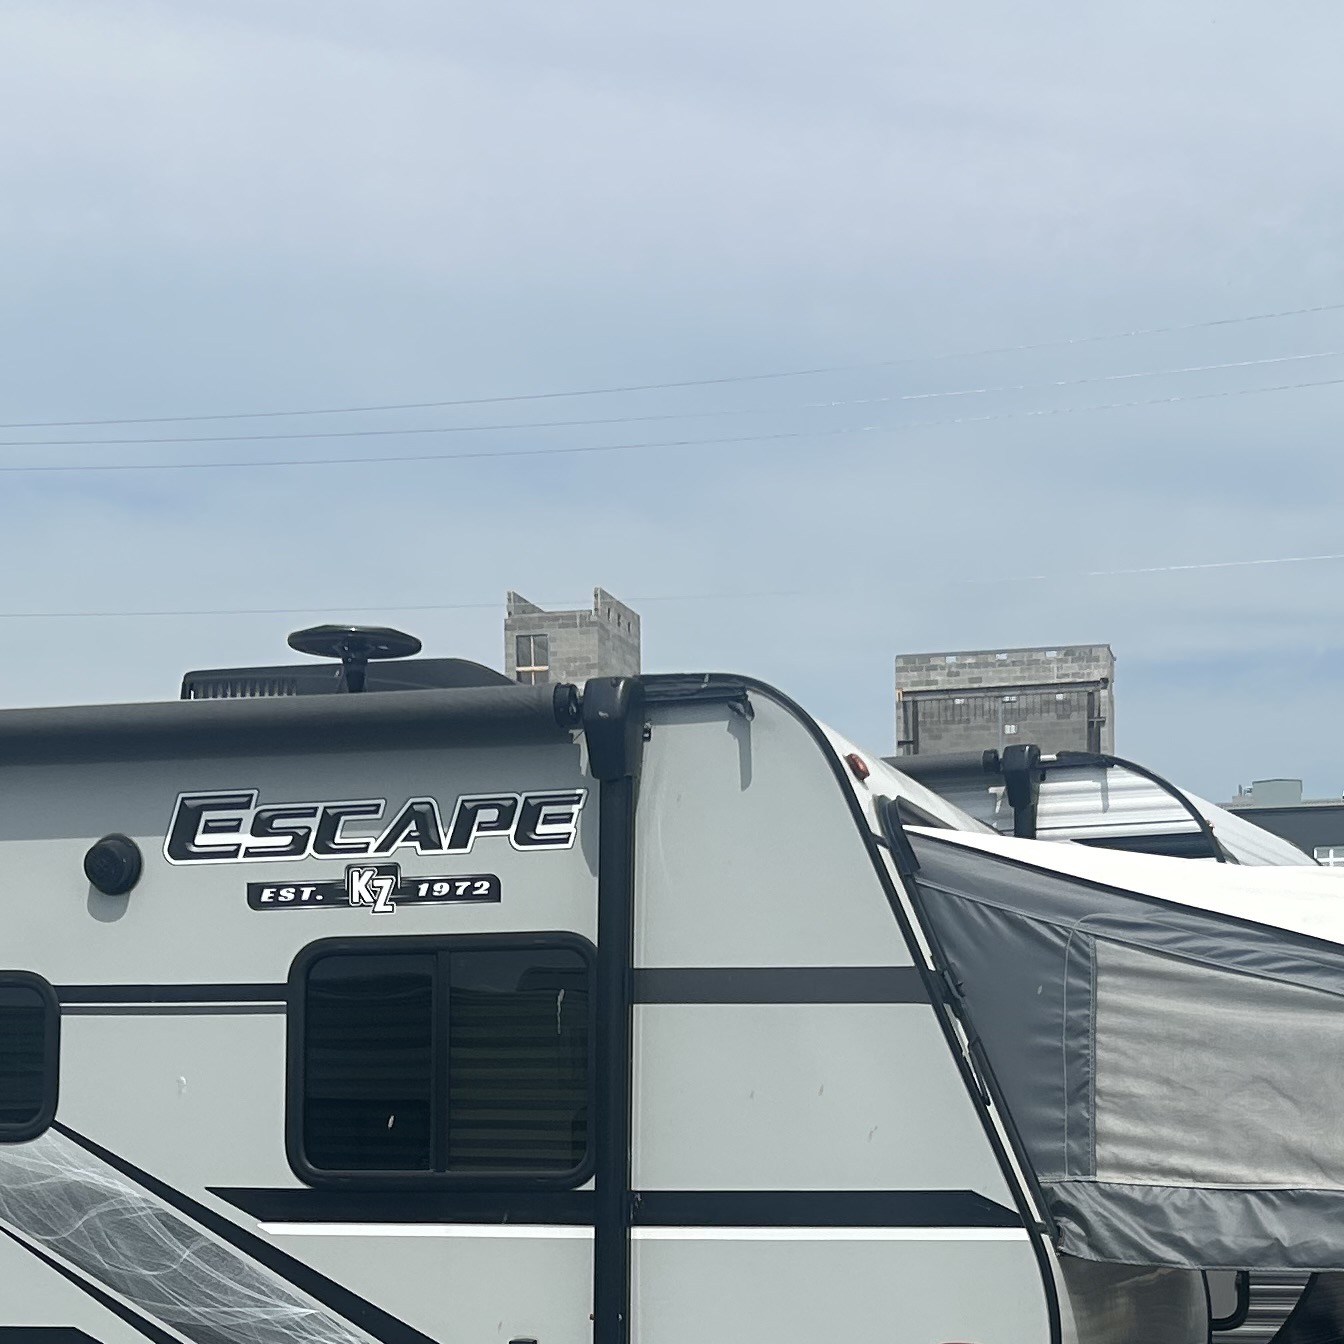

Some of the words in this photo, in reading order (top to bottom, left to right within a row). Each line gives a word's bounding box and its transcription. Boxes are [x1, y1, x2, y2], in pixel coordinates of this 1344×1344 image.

[163, 788, 589, 865] ESCAPE
[260, 886, 324, 903] EST.
[348, 868, 396, 914] KZ
[417, 880, 490, 898] 1972
